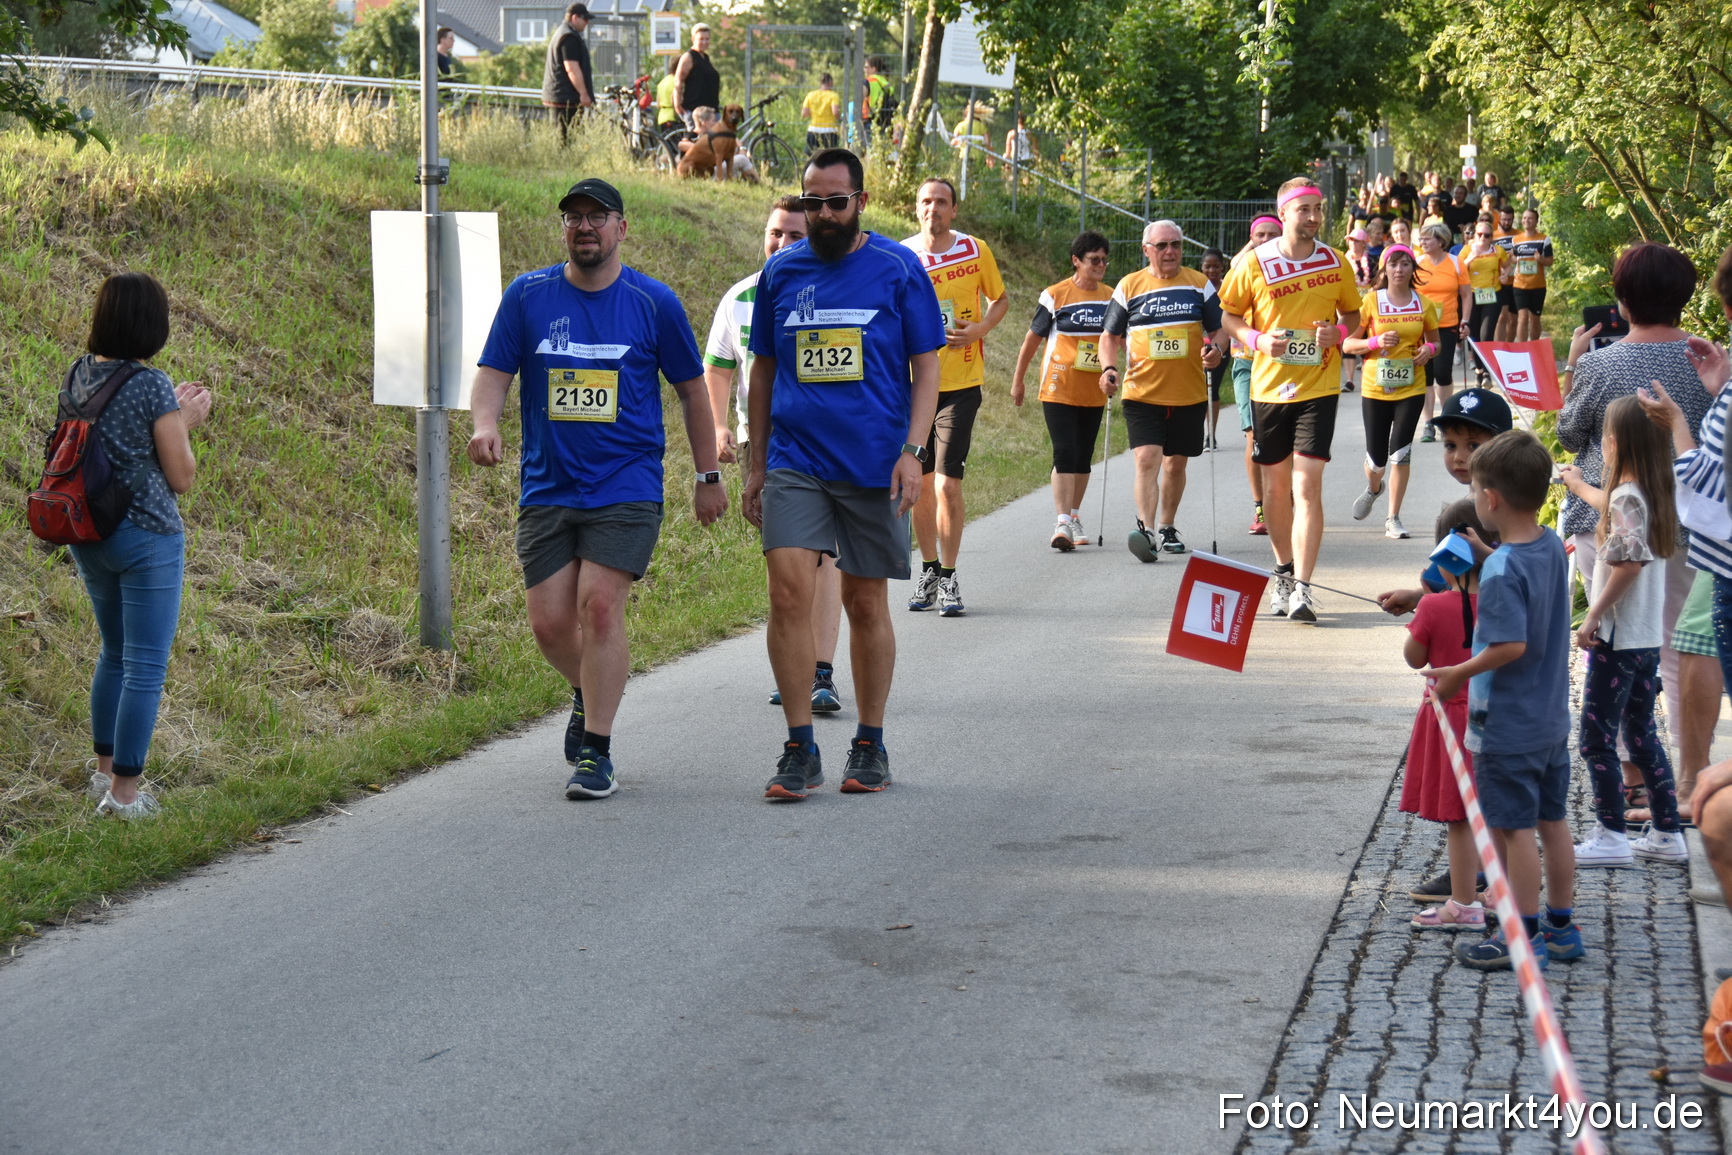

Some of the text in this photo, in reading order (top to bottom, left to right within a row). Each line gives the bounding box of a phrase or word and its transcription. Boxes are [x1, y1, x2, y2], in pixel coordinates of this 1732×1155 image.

[946, 263, 980, 281] BÖGL
[1269, 272, 1342, 300] MAX BÖGL
[1149, 301, 1195, 314] Fischer
[1154, 309, 1192, 317] AUTOMOBILE
[1378, 314, 1424, 324] MAX BÖGL
[572, 344, 618, 352] Schornsteintechnik
[1155, 339, 1180, 351] 786
[1283, 342, 1316, 356] 626
[803, 347, 853, 368] 2132
[1380, 368, 1409, 380] 1642
[556, 387, 608, 407] 2130
[1230, 595, 1249, 645] DEHN protects.
